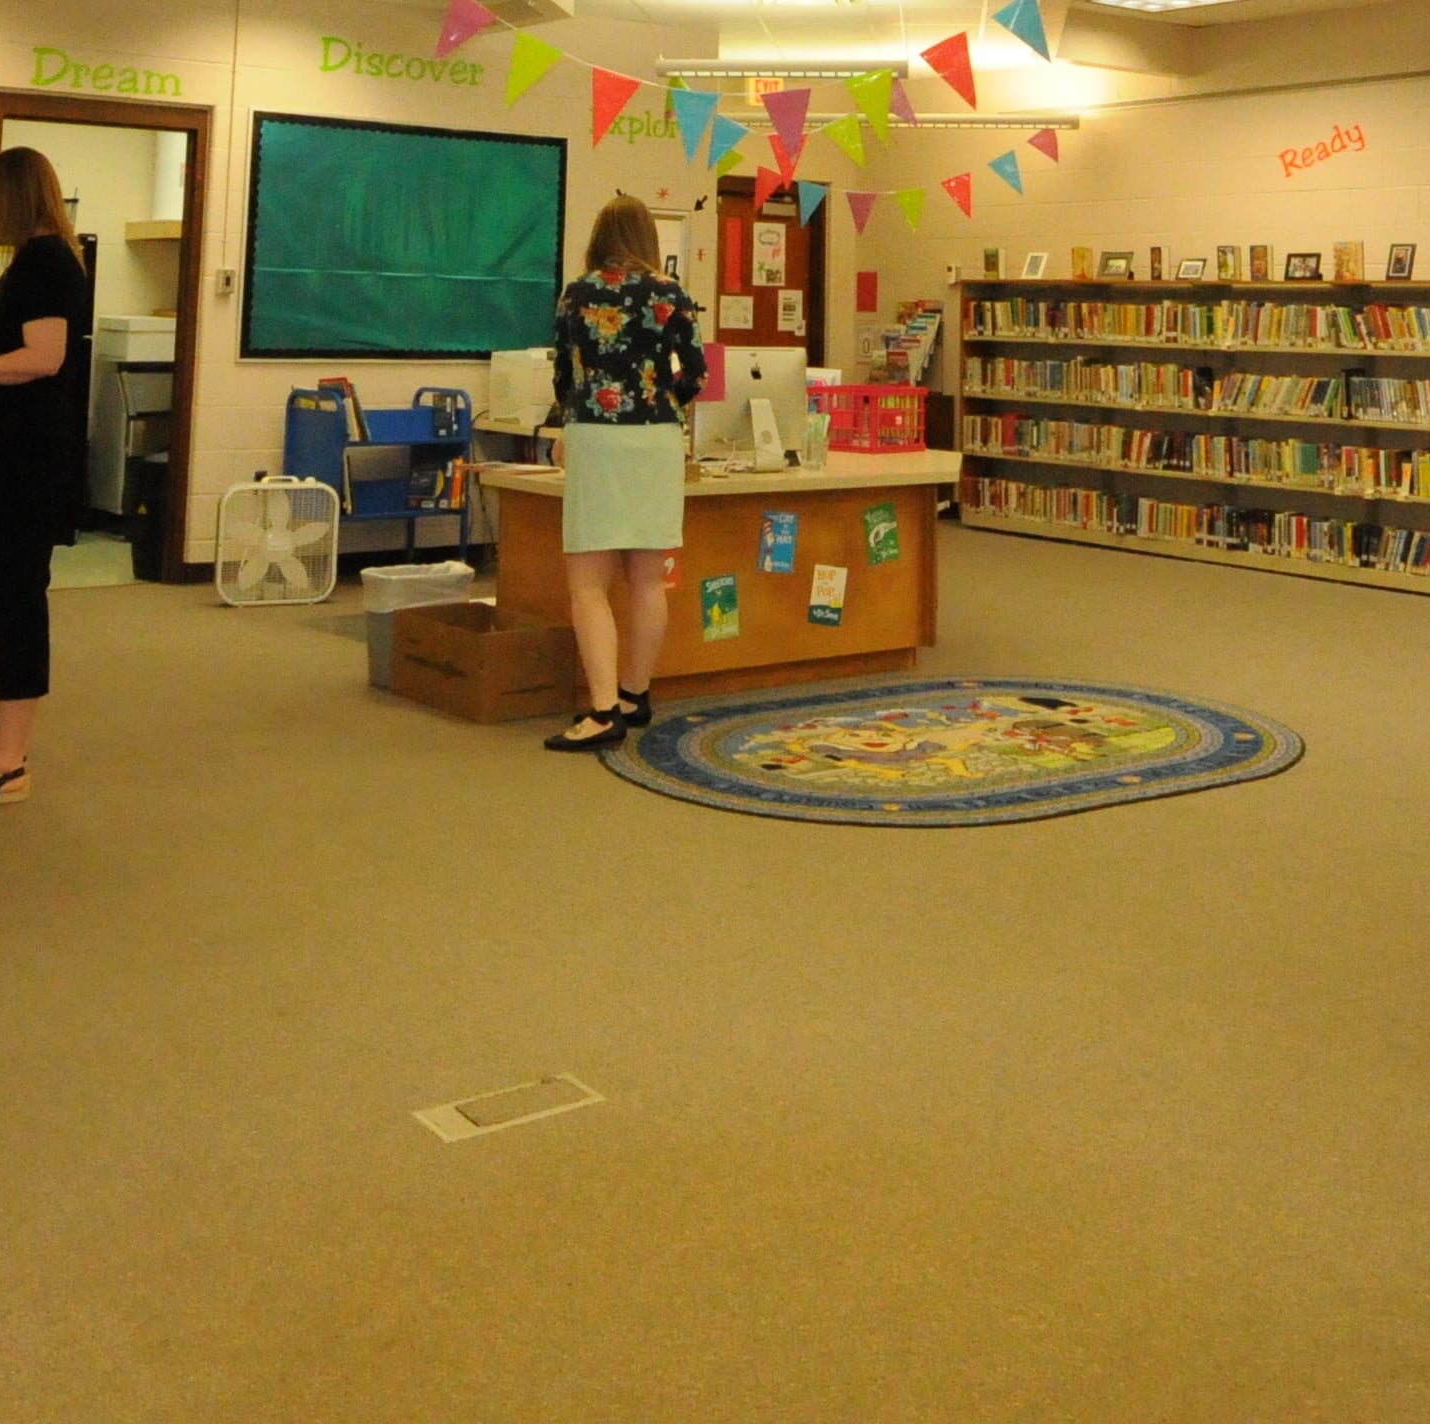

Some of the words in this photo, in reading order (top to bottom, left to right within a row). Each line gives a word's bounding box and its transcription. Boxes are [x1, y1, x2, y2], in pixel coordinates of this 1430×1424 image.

[31, 47, 183, 97] Dream
[319, 35, 484, 86] Discover
[1278, 121, 1366, 178] Ready
